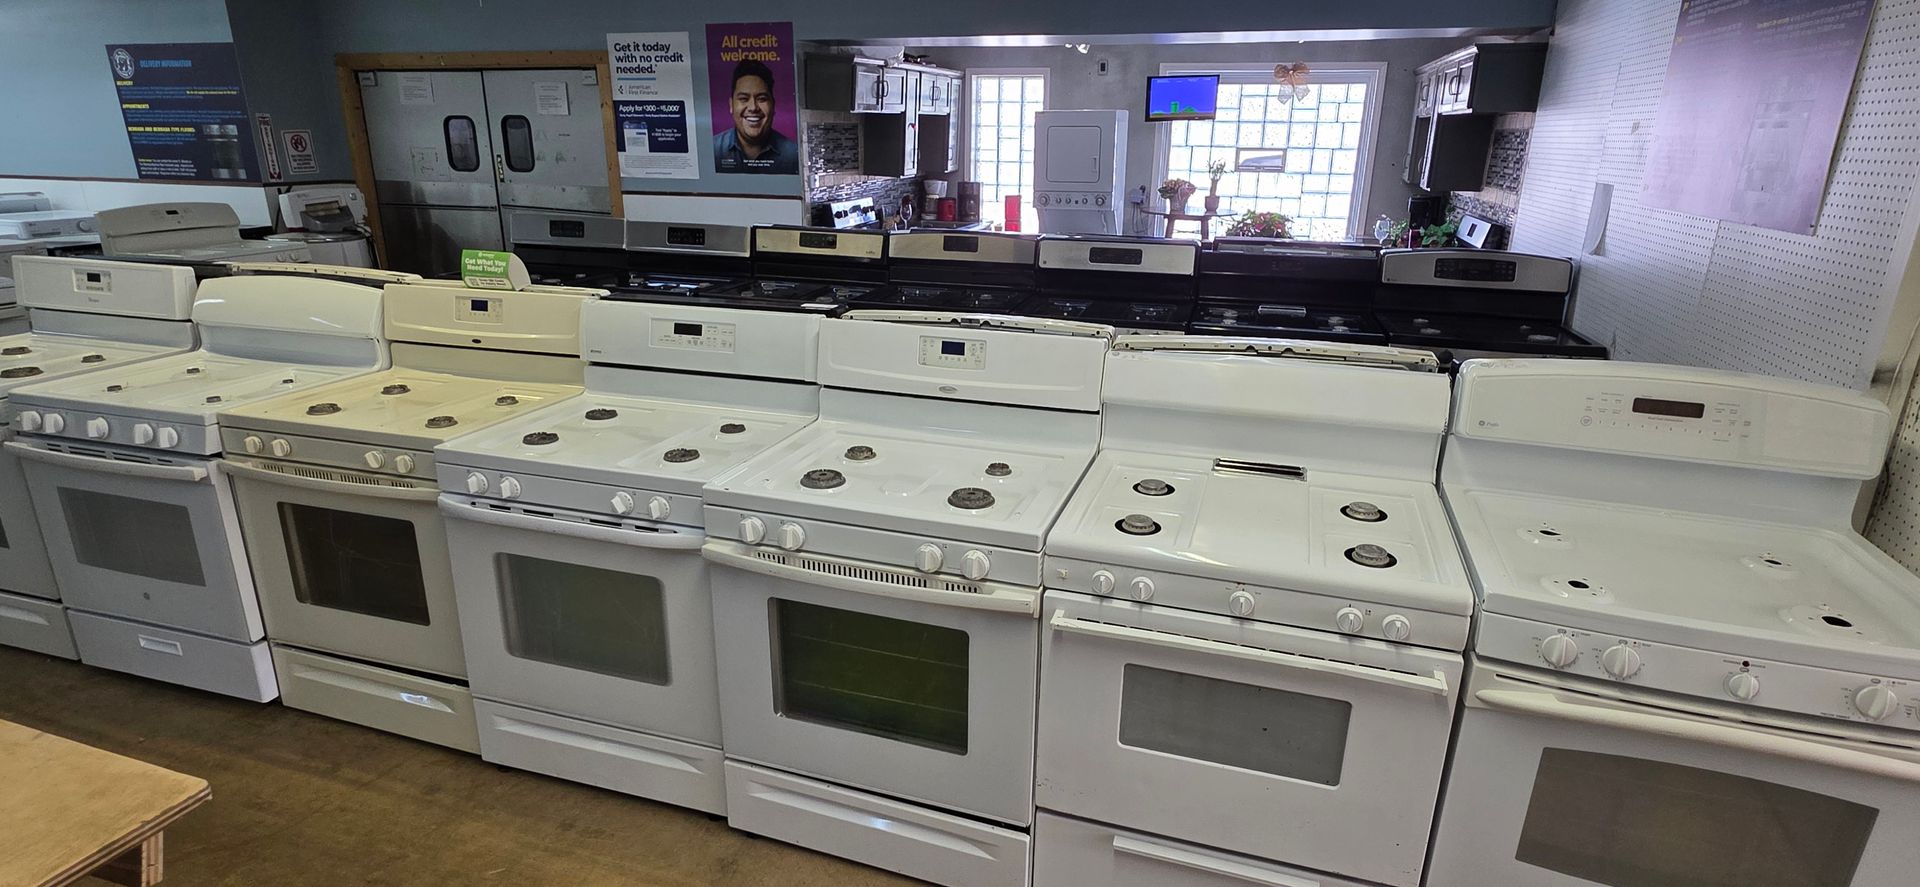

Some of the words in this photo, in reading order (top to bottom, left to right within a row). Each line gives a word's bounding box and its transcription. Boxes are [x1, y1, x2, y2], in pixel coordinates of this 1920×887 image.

[614, 42, 631, 52] Get
[633, 41, 640, 52] it
[642, 42, 671, 54] today
[722, 35, 738, 48] All
[740, 34, 778, 48] credit
[615, 52, 637, 63] with
[640, 54, 652, 63] no
[654, 51, 684, 63] credit
[721, 49, 781, 62] welcome.
